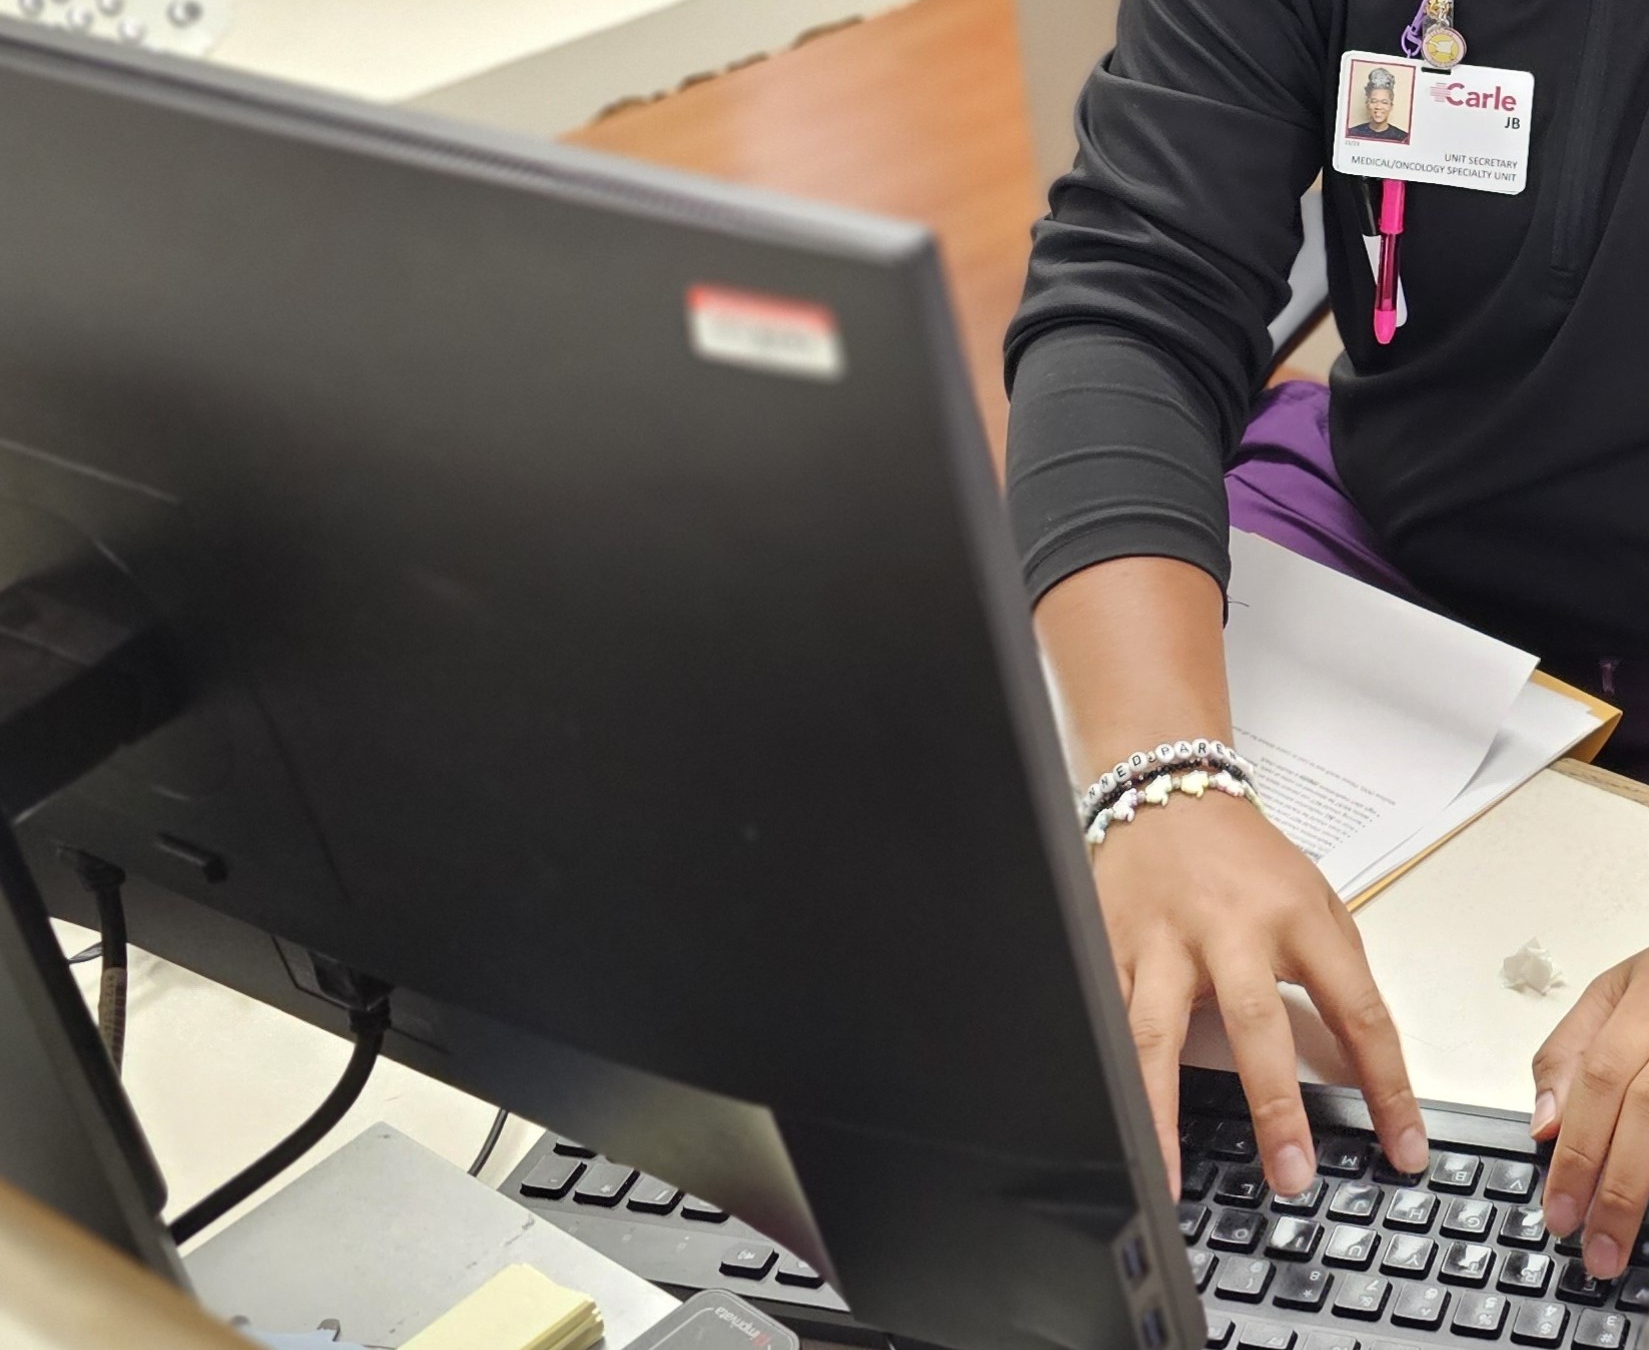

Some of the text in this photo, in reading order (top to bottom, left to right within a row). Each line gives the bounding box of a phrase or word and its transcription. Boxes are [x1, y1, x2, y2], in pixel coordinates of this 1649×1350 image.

[1444, 82, 1517, 112] Carle
[1504, 117, 1521, 130] JB
[1444, 153, 1518, 169] UNIT SECRETARY
[1351, 155, 1517, 183] MEDICAL/ONCOLOGY SPECIALTY UNIT
[1342, 1156, 1357, 1165] M
[1455, 1171, 1467, 1181] B
[1243, 1185, 1253, 1194] L
[1509, 1180, 1522, 1189] V
[1410, 1207, 1424, 1218] H
[1467, 1216, 1481, 1227] G
[1350, 1245, 1362, 1256] U
[1403, 1255, 1419, 1265] Y
[1311, 1271, 1321, 1280] 8
[1522, 1269, 1537, 1282] R
[1369, 1280, 1380, 1290] 7
[1485, 1298, 1498, 1308] 5
[1545, 1305, 1557, 1316] 4
[715, 1306, 761, 1340] imprivata
[1606, 1316, 1617, 1325] 3
